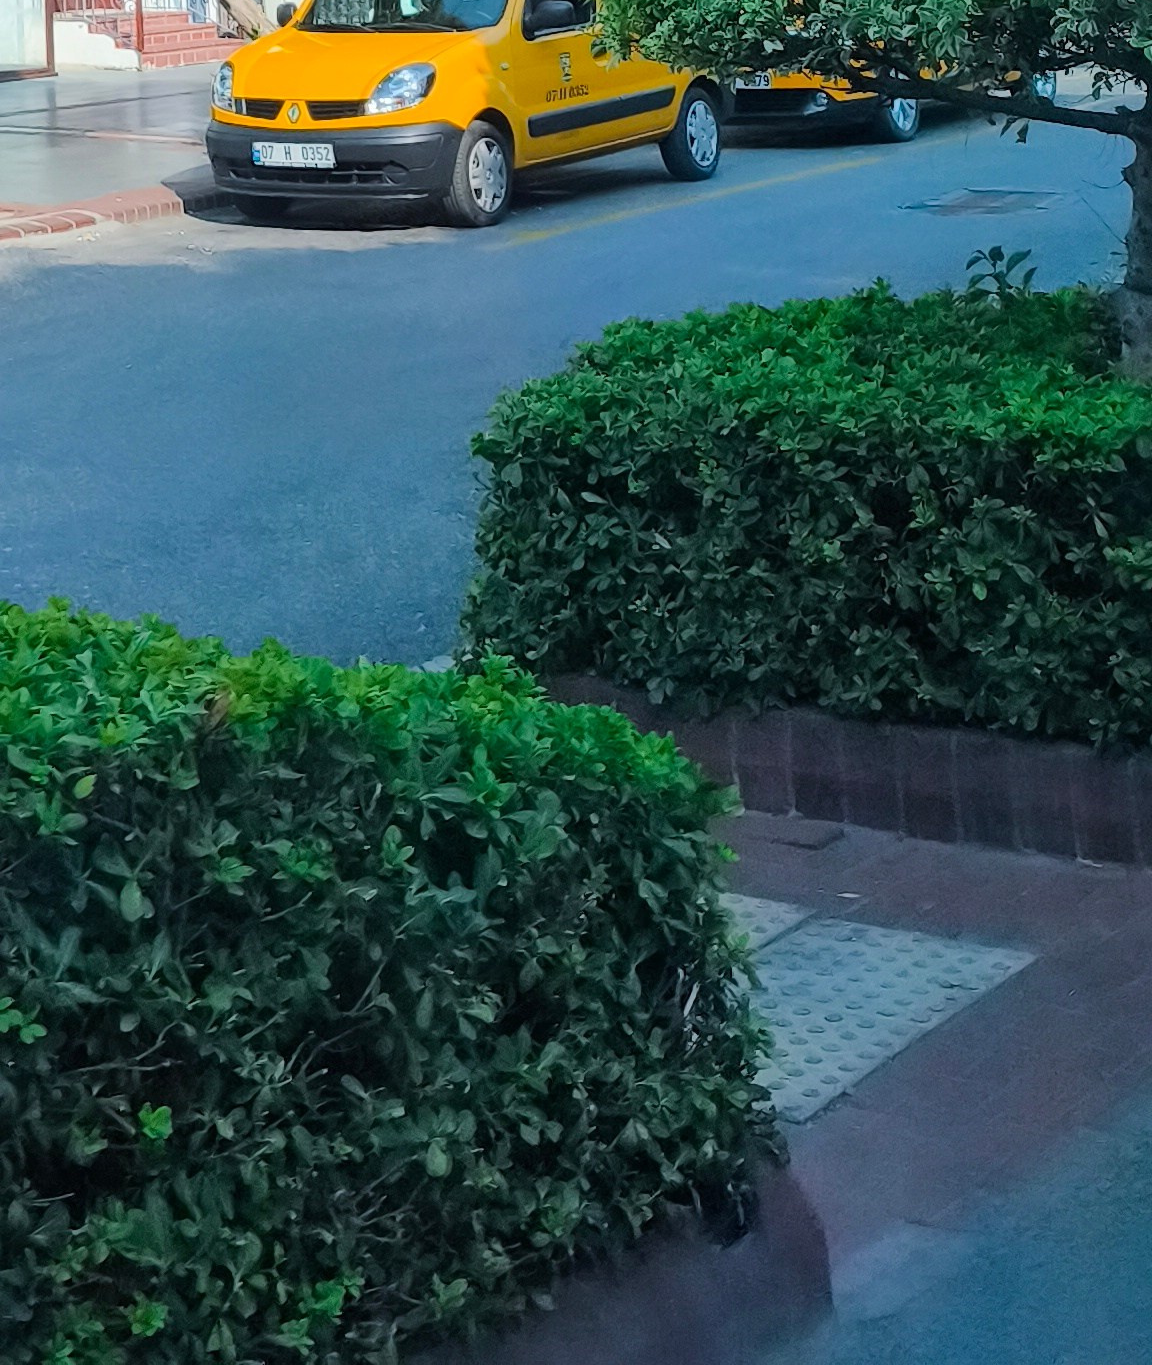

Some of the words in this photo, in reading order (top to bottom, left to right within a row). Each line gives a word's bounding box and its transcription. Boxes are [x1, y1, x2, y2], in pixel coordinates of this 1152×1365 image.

[261, 145, 274, 160] 07
[283, 145, 292, 161] H
[301, 146, 332, 161] 0352
